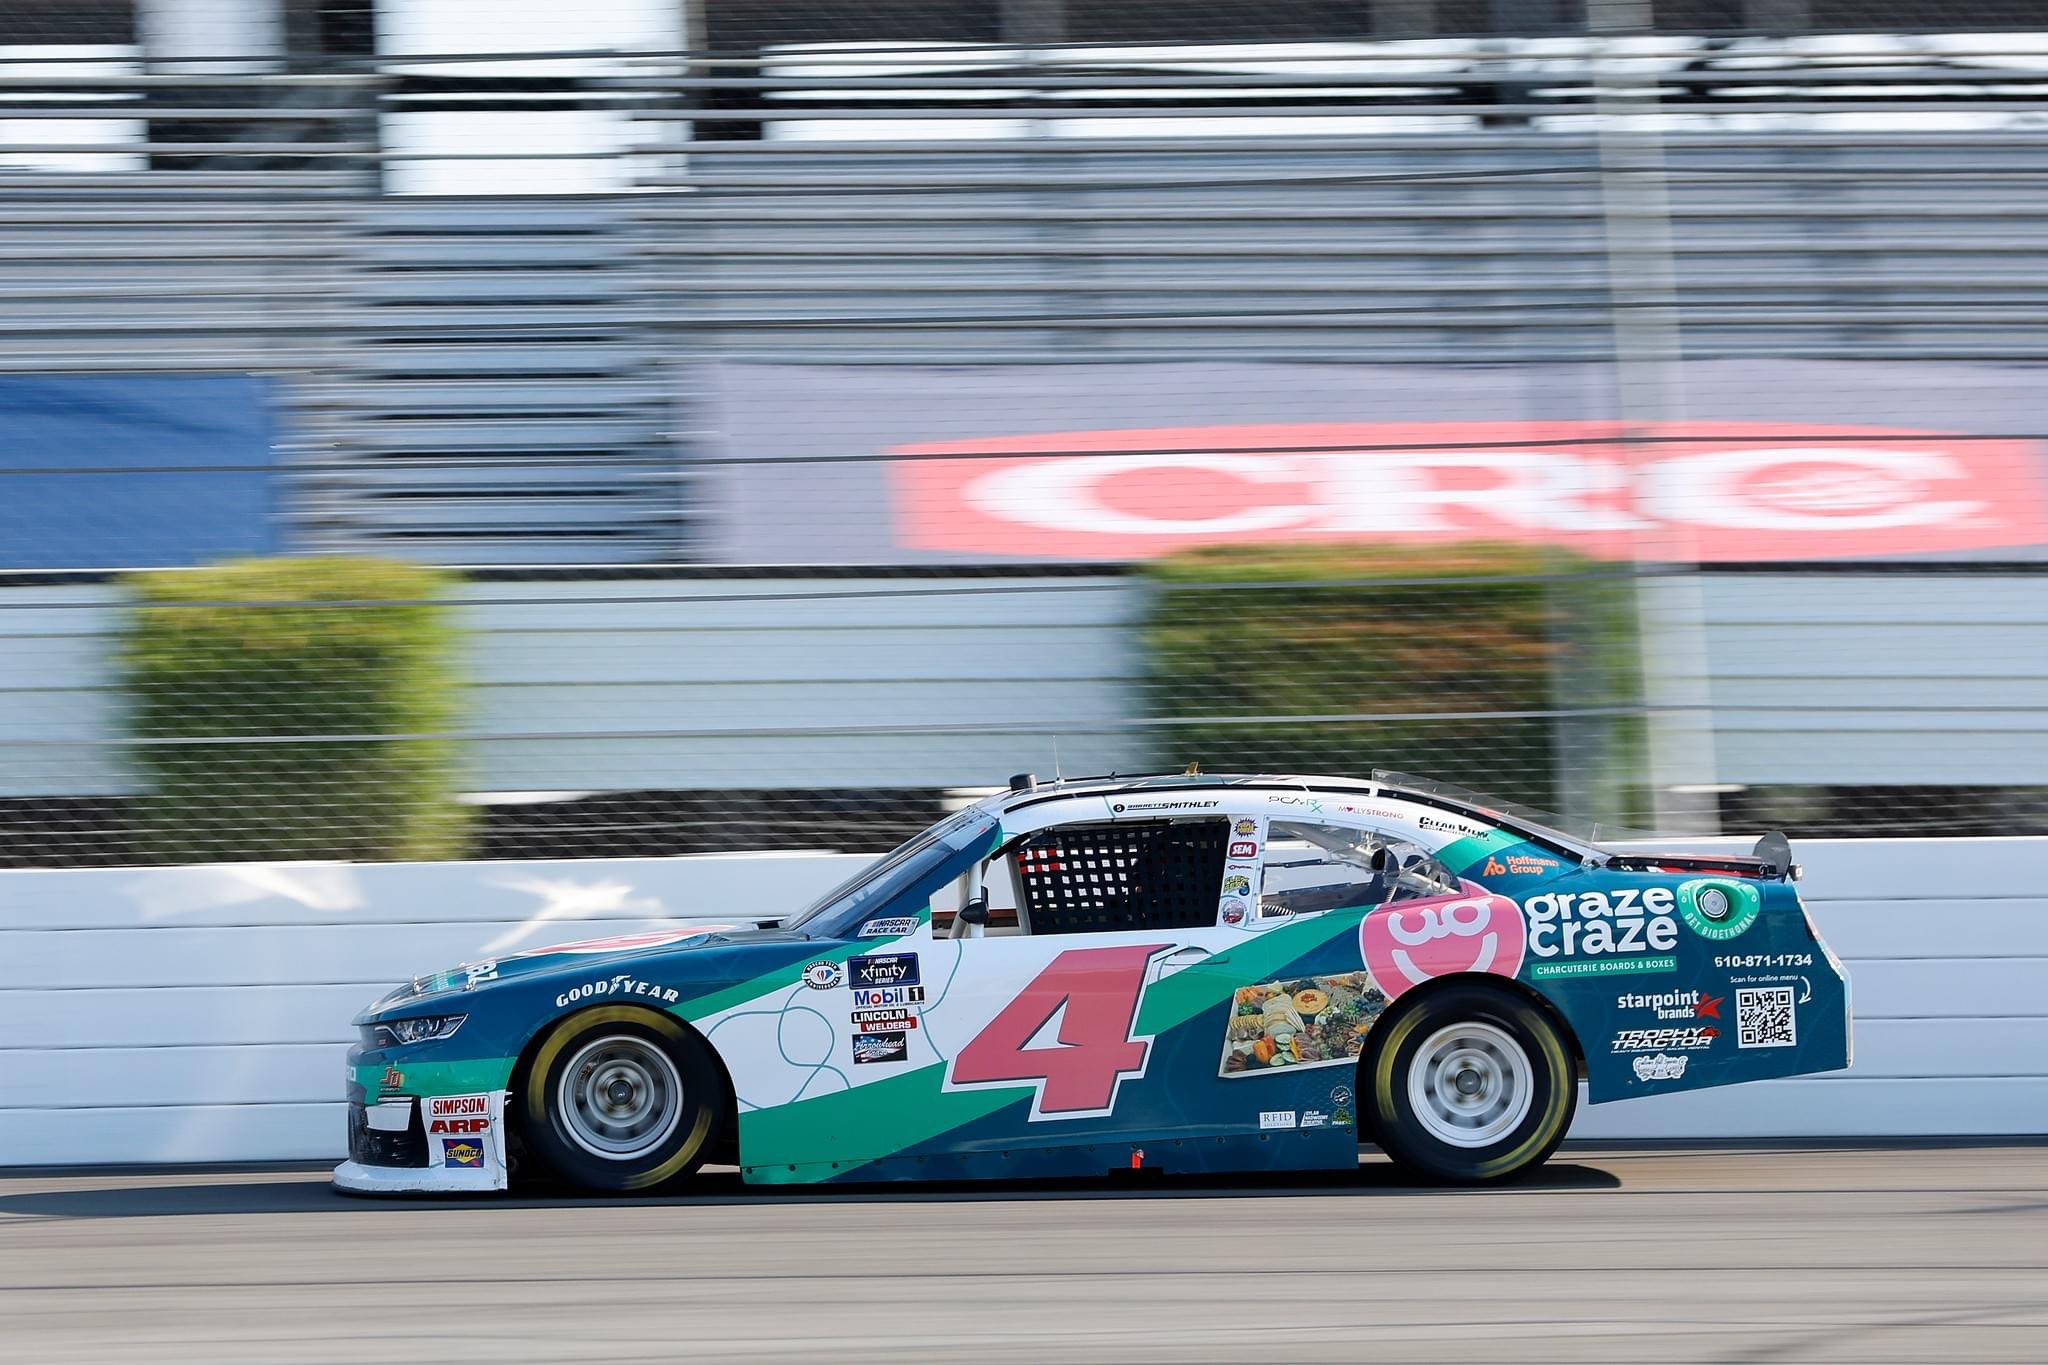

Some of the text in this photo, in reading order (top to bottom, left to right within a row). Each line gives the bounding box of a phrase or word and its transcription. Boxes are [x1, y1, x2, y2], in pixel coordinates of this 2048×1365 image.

[961, 449, 1998, 534] CRC
[1161, 801, 1220, 810] SMITHLEY
[1231, 844, 1253, 855] SEM
[1506, 856, 1560, 867] Hoffmann
[1510, 865, 1544, 876] Group
[1524, 887, 1675, 924] graze
[866, 926, 908, 935] RACE CAR
[879, 919, 912, 928] NASCAR
[1529, 916, 1679, 957] craze
[874, 956, 899, 965] NASCAR
[1536, 958, 1675, 976] CHARCUTERIE BOARDS & BOXES
[1714, 953, 1813, 968] 610-871-1734
[860, 964, 908, 982] xfinity
[1730, 974, 1798, 984] Scan for online menu
[874, 976, 895, 985] SERIES
[556, 977, 679, 1007] GOODYEAR
[854, 987, 904, 1006] Mobil
[1617, 989, 1700, 1011] starpoint
[853, 1009, 905, 1023] LINCOLN
[1657, 1005, 1695, 1020] brands
[865, 1020, 912, 1032] WELDERS
[945, 943, 1178, 1118] 4
[1617, 1027, 1707, 1041] TROPHY
[1611, 1036, 1714, 1050] TRACTOR
[433, 1097, 486, 1115] SIMPSON
[1263, 1112, 1292, 1122] RFID
[430, 1119, 490, 1133] ARP
[447, 1148, 482, 1159] SUNOCO
